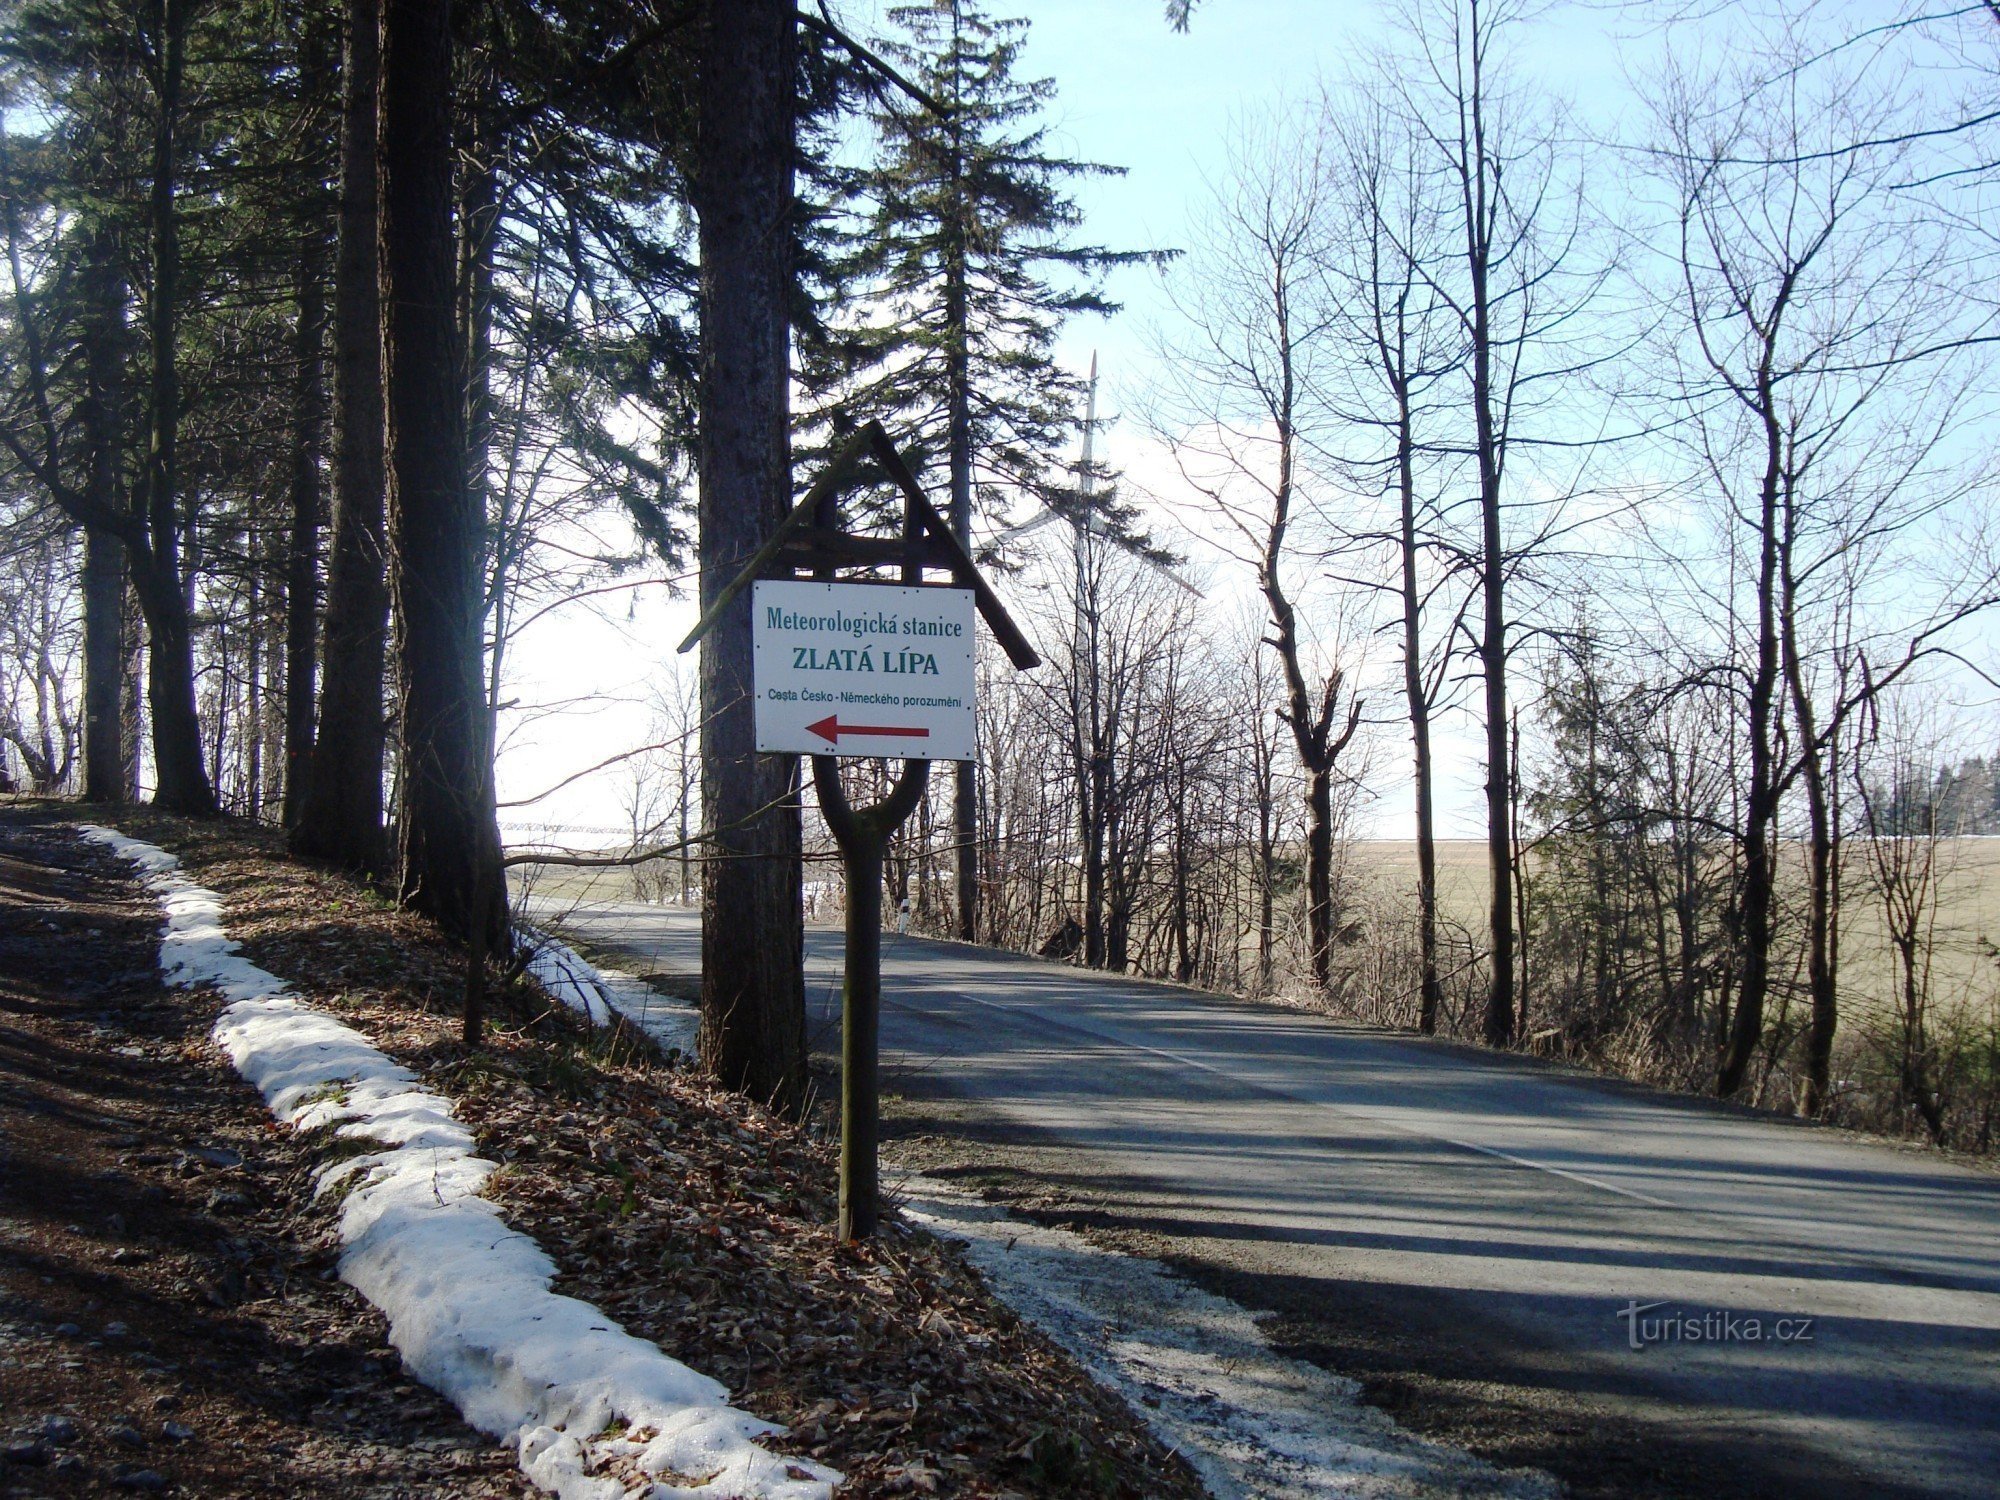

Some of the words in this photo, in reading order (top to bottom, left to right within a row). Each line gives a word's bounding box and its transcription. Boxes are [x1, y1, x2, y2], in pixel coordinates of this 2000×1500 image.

[766, 606, 898, 638] Meteorologická
[903, 616, 962, 637] stanice
[793, 644, 875, 672] ZLATÁ
[883, 646, 940, 675] LÍPA
[903, 696, 962, 708] porozumění
